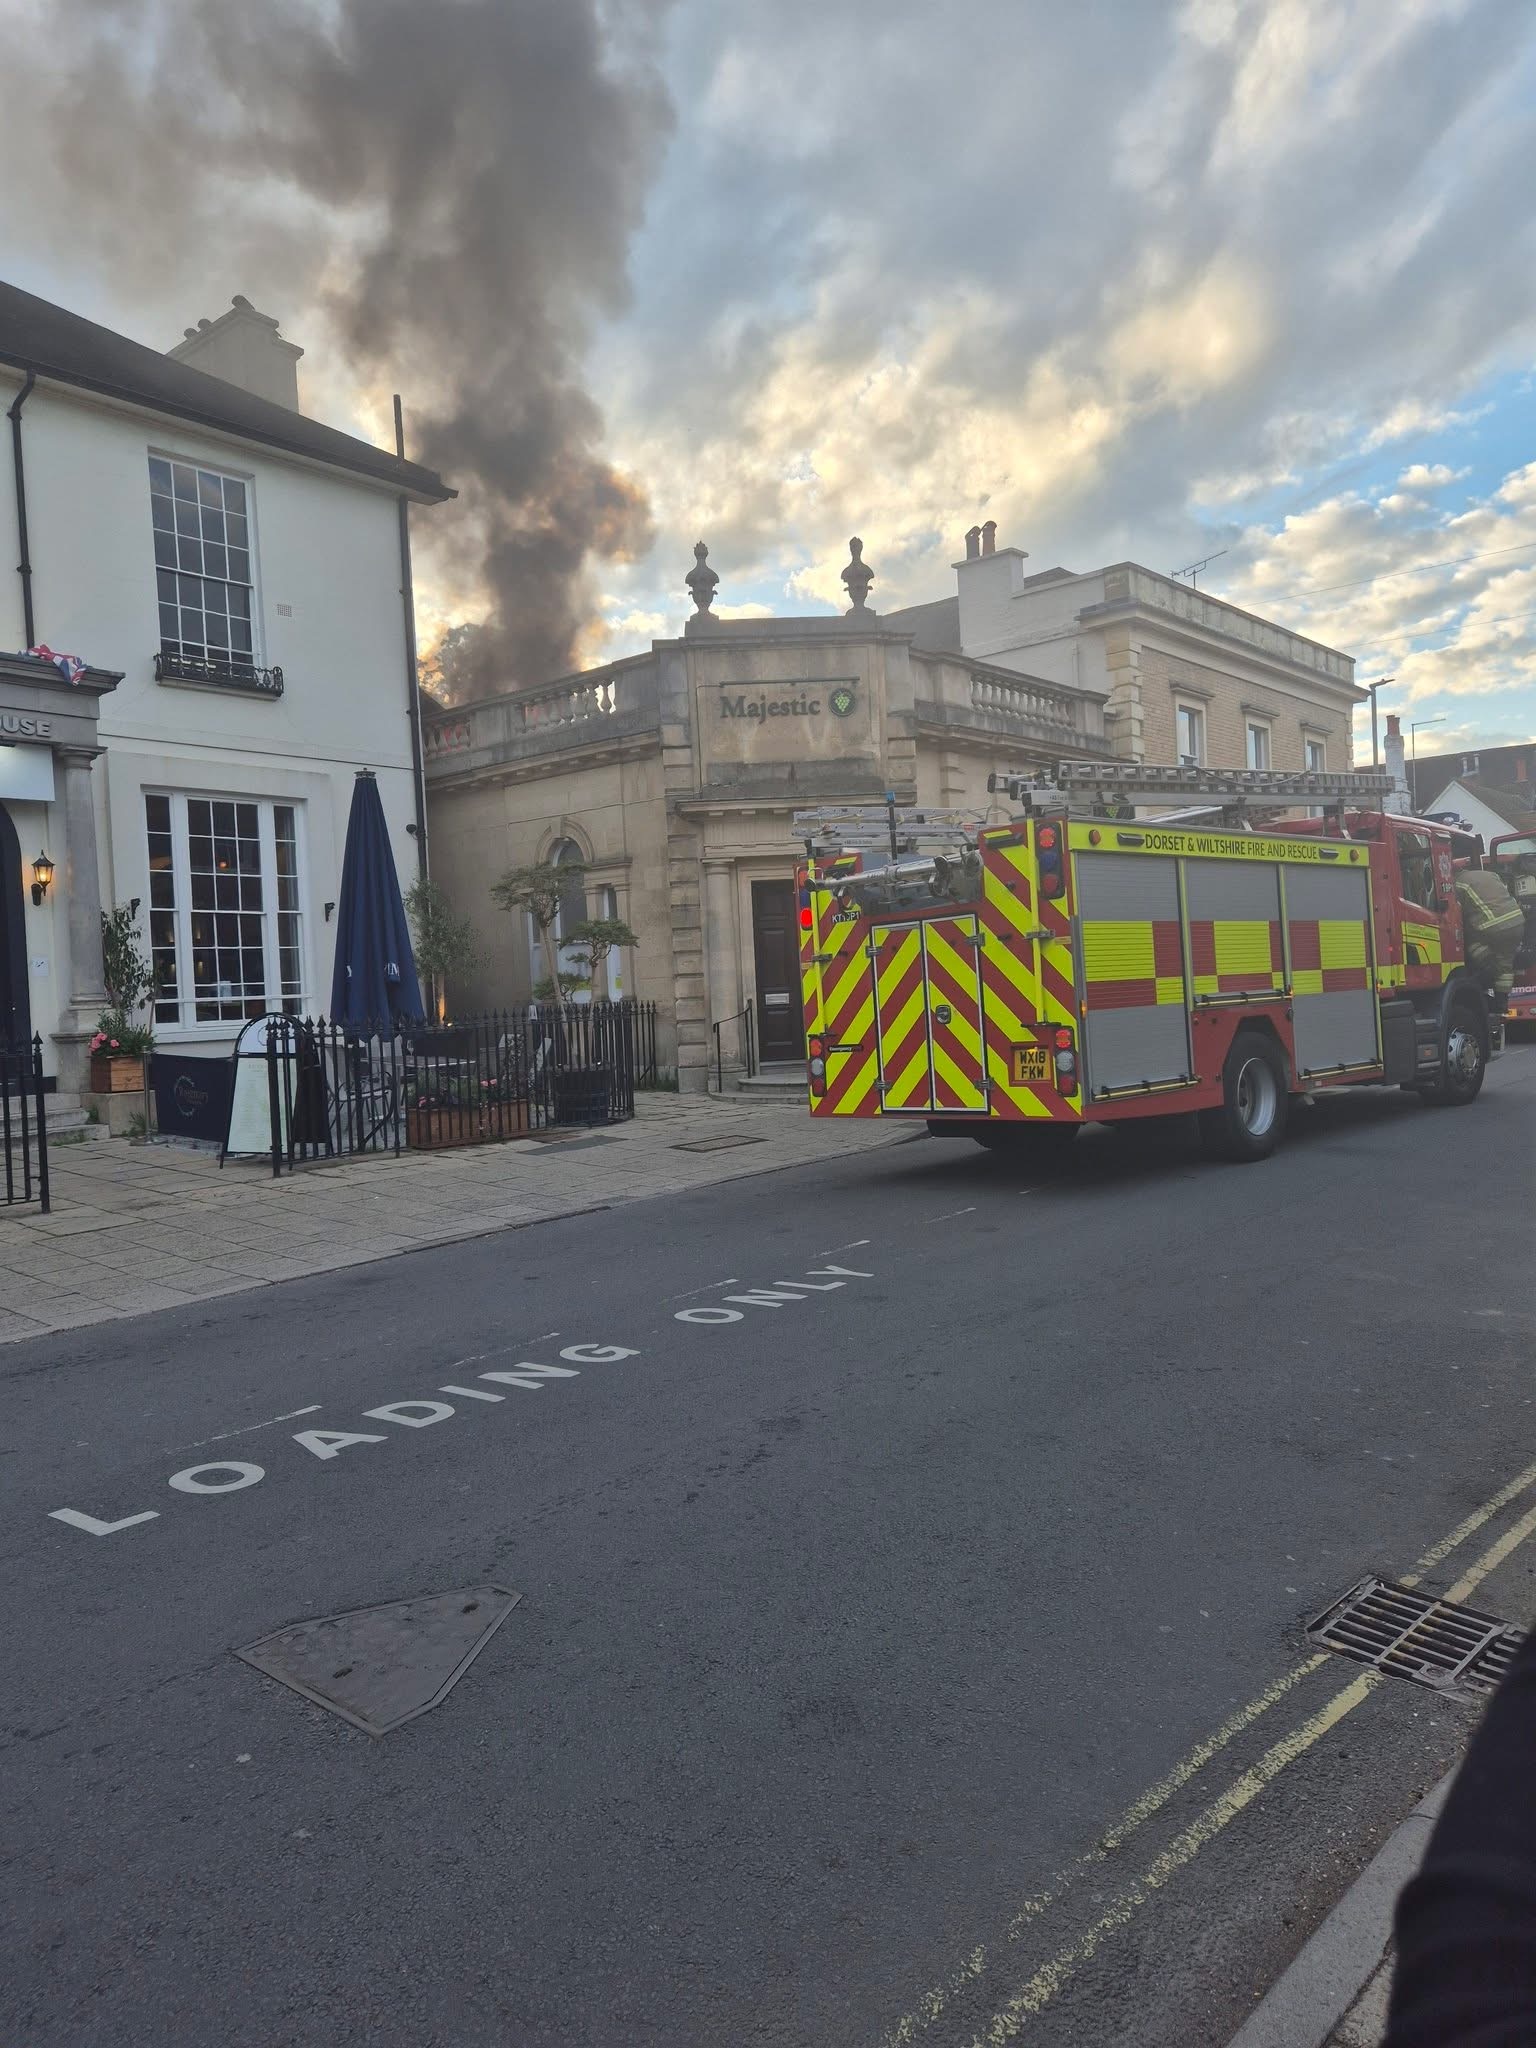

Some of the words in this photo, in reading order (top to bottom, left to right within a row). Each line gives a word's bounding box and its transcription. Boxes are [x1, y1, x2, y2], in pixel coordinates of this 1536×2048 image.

[720, 692, 821, 725] Majestic
[0, 715, 50, 737] USE
[1145, 833, 1185, 851] DORSET
[1187, 837, 1195, 852] &
[1197, 838, 1246, 857] WILTSHIRE
[1247, 841, 1265, 857] FIRE
[1267, 843, 1286, 858] AND
[1287, 844, 1318, 860] RESCUE
[1020, 1051, 1046, 1064] WX18
[1021, 1065, 1044, 1079] FKW
[47, 1343, 642, 1537] LOADING
[674, 1264, 875, 1324] ONLY
